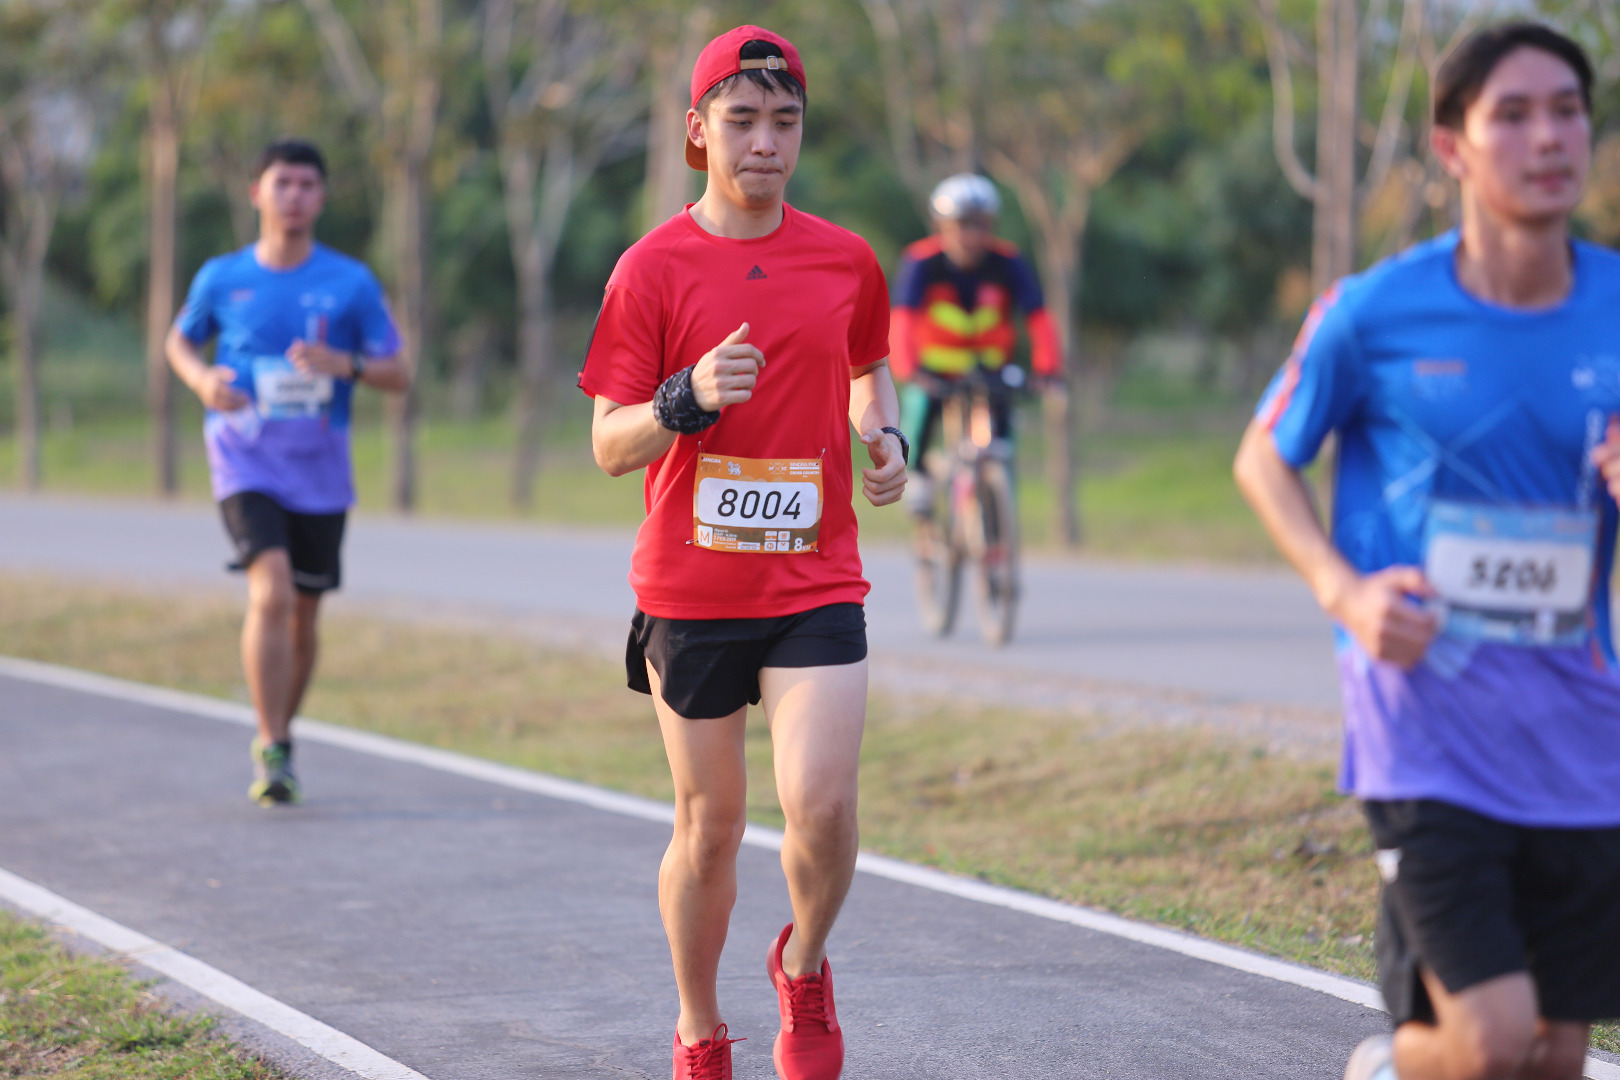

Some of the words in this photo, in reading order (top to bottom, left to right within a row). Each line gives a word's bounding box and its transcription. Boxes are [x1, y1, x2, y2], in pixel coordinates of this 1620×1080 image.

[717, 488, 801, 520] 8004
[700, 530, 709, 544] M
[794, 537, 803, 552] 8
